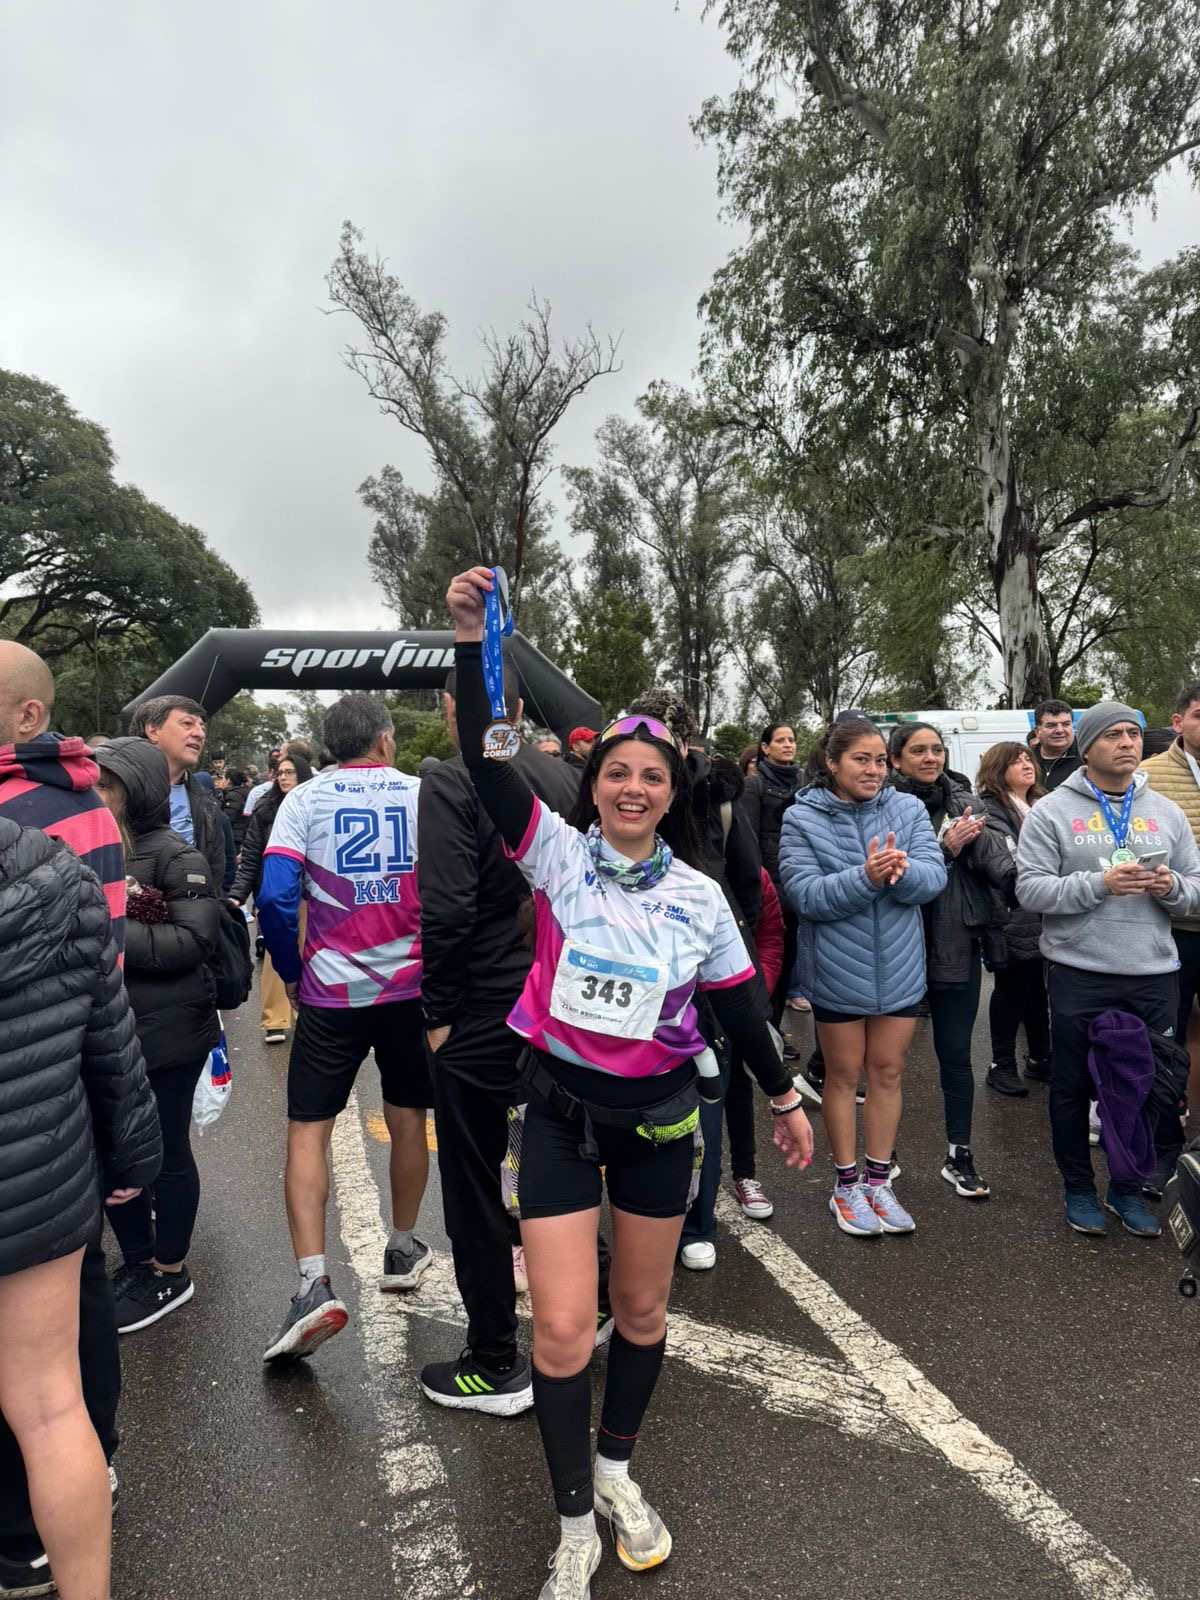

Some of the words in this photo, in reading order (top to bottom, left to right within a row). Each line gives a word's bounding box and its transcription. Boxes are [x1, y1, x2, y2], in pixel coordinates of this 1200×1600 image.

[1072, 811, 1159, 832] adas
[335, 806, 413, 874] 21
[1074, 834, 1162, 846] ORIGALS
[355, 879, 399, 904] KM
[664, 912, 691, 925] CORRE
[666, 905, 685, 915] SMT
[581, 975, 633, 1008] 343
